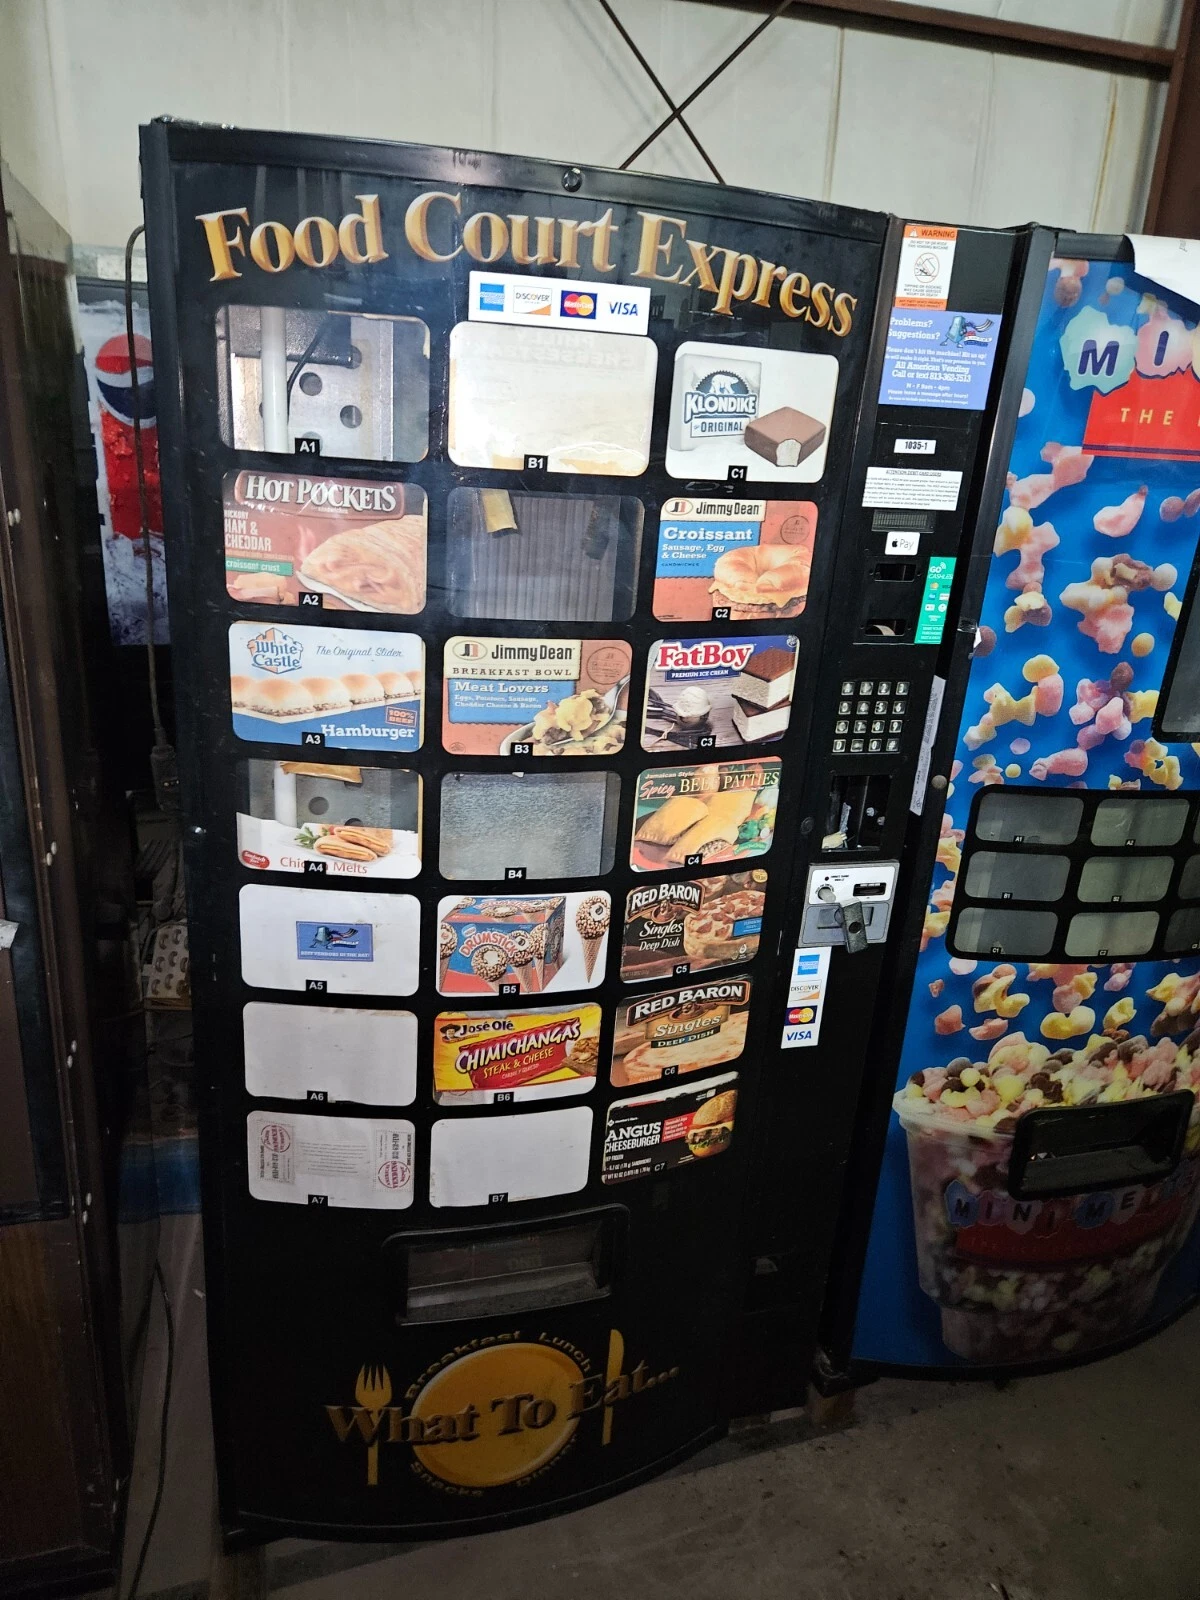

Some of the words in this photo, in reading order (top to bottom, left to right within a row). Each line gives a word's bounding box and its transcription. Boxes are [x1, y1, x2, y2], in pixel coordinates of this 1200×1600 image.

[921, 229, 955, 238] WARNING
[195, 193, 390, 282] Food
[404, 191, 616, 273] Court
[631, 209, 859, 338] Express
[515, 292, 550, 301] DISCOVER
[609, 302, 639, 316] VISA
[890, 317, 933, 328] Problems?
[888, 328, 940, 340] Suggestions?
[894, 360, 905, 369] All
[907, 362, 940, 371] American
[942, 364, 970, 375] Vending
[892, 370, 907, 378] Call
[915, 372, 929, 380] text
[684, 393, 757, 423] KLONDIKE
[1121, 408, 1174, 425] THE
[700, 421, 743, 433] ORIGINAL
[300, 442, 316, 453] A1
[905, 441, 928, 450] 1035-1
[528, 458, 544, 469] B1
[731, 468, 744, 479] C1
[246, 476, 294, 502] HOT
[297, 479, 397, 512] POCKETS
[224, 518, 247, 535] HAM
[250, 521, 258, 536] &
[664, 527, 753, 541] Croissant
[225, 534, 272, 552] CHEDDAR
[662, 544, 704, 552] Sausage,
[706, 545, 725, 553] Egg
[900, 539, 914, 551] Pay
[226, 560, 259, 570] croissant
[262, 564, 280, 572] crust
[302, 595, 319, 606] A2
[715, 609, 728, 619] C2
[255, 640, 297, 656] White
[316, 646, 333, 656] The
[334, 646, 372, 661] Original
[252, 654, 301, 668] Castle
[658, 644, 752, 668] FatBoy
[453, 667, 530, 676] BREAKFAST
[535, 669, 572, 677] BOWL
[454, 681, 494, 693] Meat
[498, 683, 549, 693] Lovers
[389, 710, 414, 719] 100%
[321, 724, 416, 740] Hamburger
[306, 735, 321, 745] A3
[700, 738, 713, 747] C3
[514, 745, 530, 754] B3
[640, 780, 676, 799] Spicy
[723, 772, 780, 790] PATTIES
[333, 859, 368, 874] Melts
[688, 857, 700, 866] C4
[309, 864, 323, 872] A4
[508, 870, 523, 879] B4
[631, 889, 658, 911] RED
[659, 884, 700, 904] BARON
[640, 919, 684, 939] Singles
[459, 932, 519, 958] DRUMSTICK
[639, 940, 660, 951] Deep
[661, 938, 681, 949] Dish
[309, 982, 323, 990] A5
[503, 986, 517, 994] B5
[791, 984, 819, 992] DISCOVER
[634, 996, 676, 1020] RED
[678, 985, 744, 1004] BARON
[459, 1022, 491, 1036] José
[492, 1021, 514, 1031] Olé
[654, 1015, 722, 1038] Singles
[658, 1038, 686, 1047] DEEP
[689, 1030, 715, 1041] DISH
[787, 1030, 812, 1041] VISA
[455, 1022, 582, 1075] CHIMICHANGAS
[484, 1063, 510, 1079] STEAK
[514, 1060, 521, 1069] &
[523, 1048, 554, 1066] CHEESE
[665, 1067, 676, 1076] C6
[310, 1093, 324, 1101] A6
[497, 1094, 511, 1102] B6
[605, 1122, 662, 1143] ANGUS
[605, 1134, 661, 1154] CHEESEBURGER
[655, 1163, 665, 1172] C7
[492, 1195, 505, 1203] B7
[405, 1330, 522, 1399] Breakfast
[538, 1332, 591, 1373] Lunch
[324, 1404, 480, 1446] What
[491, 1392, 558, 1437] To
